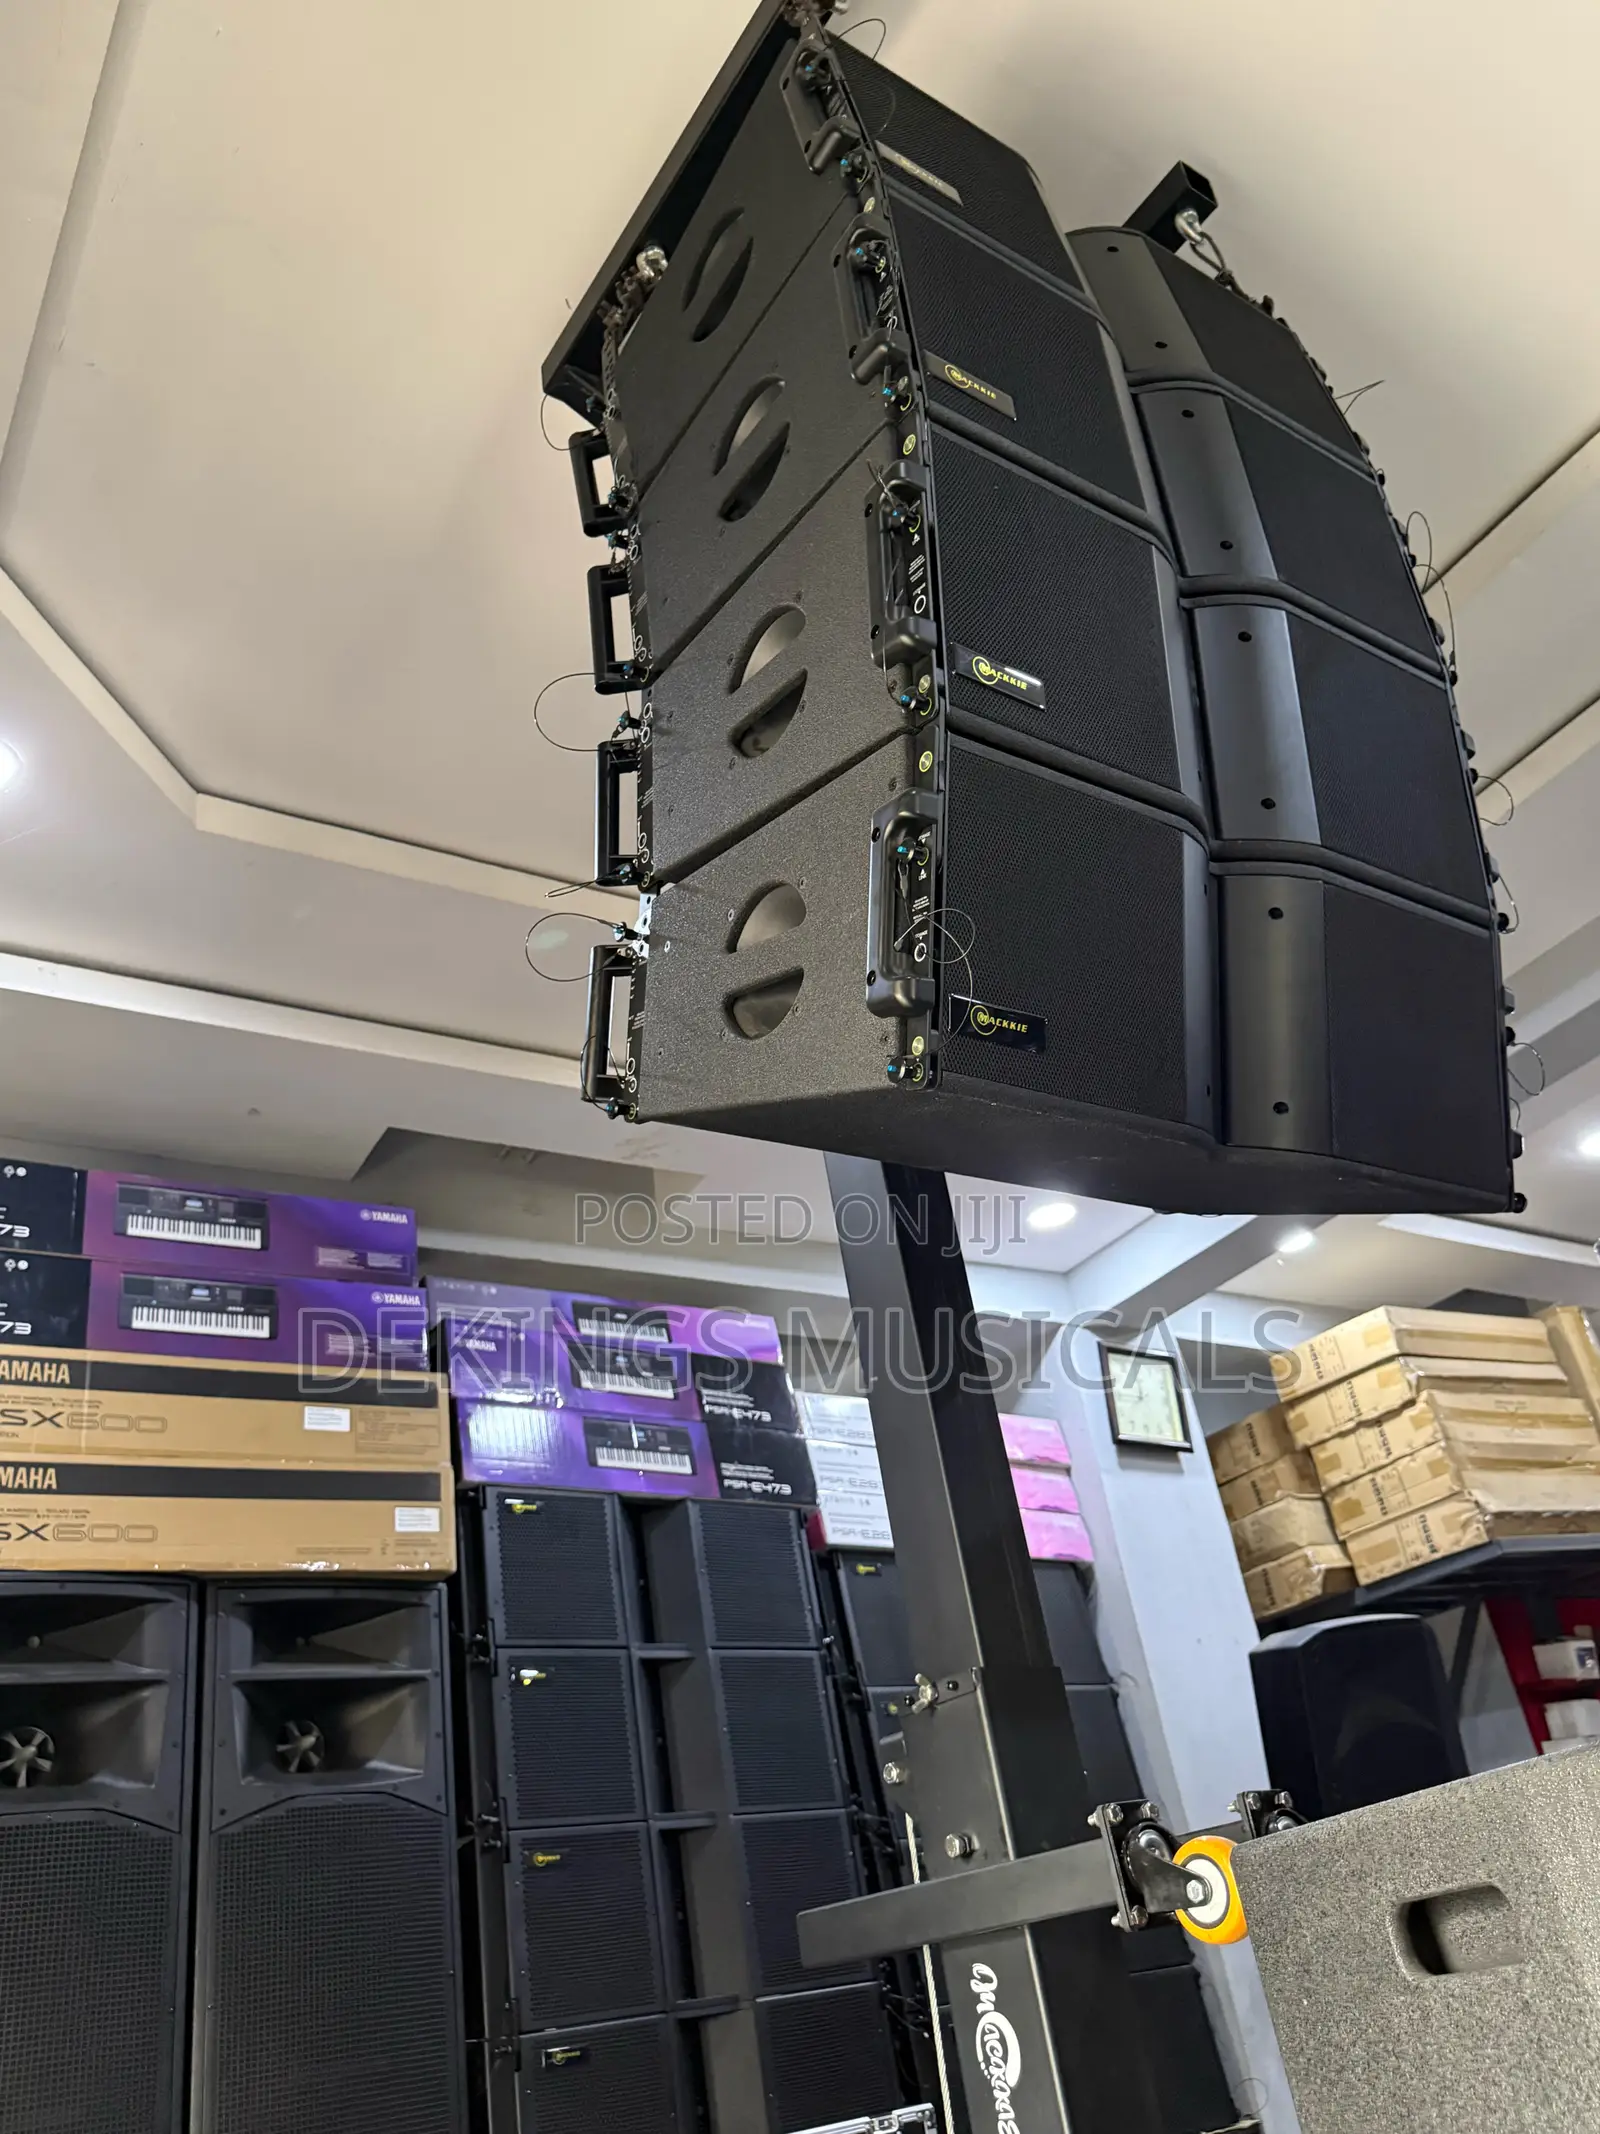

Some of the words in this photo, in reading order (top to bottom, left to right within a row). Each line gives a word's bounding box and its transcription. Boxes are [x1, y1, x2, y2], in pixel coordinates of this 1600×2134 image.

[972, 656, 1028, 690] MACKKIE
[971, 1005, 1028, 1036] MACKKIE
[371, 1211, 408, 1224] YAMAHA
[383, 1293, 421, 1306] YAMAHA
[723, 1478, 792, 1496] PSR-E473
